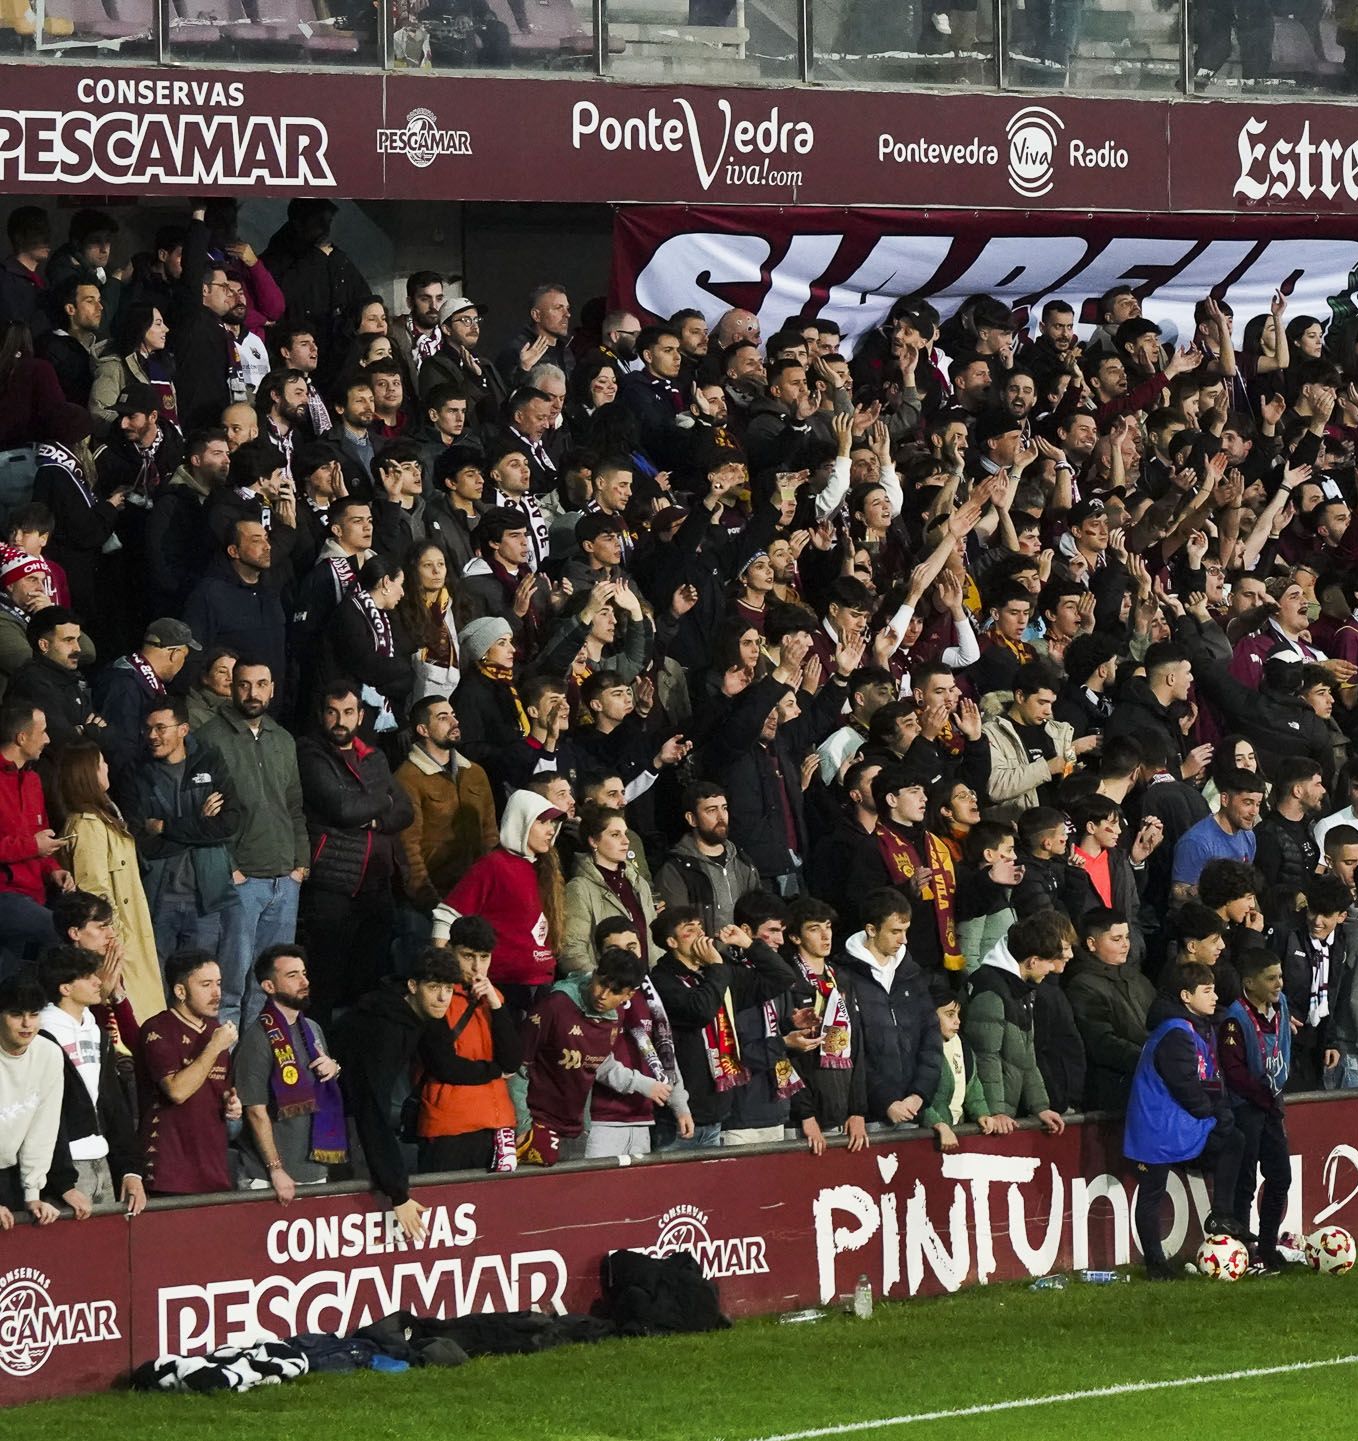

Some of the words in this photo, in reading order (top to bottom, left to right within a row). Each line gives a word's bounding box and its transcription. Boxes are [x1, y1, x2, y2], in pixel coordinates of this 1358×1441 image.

[77, 78, 245, 106] CONSERVAS
[376, 129, 472, 154] PESCAMAR
[879, 134, 998, 165] Pontevedra
[1013, 138, 1052, 168] Viva
[1070, 140, 1129, 168] Radio
[934, 874, 949, 910] VILA
[657, 1204, 710, 1229] CONSERVAS
[0, 1266, 51, 1291] ONSERVAS
